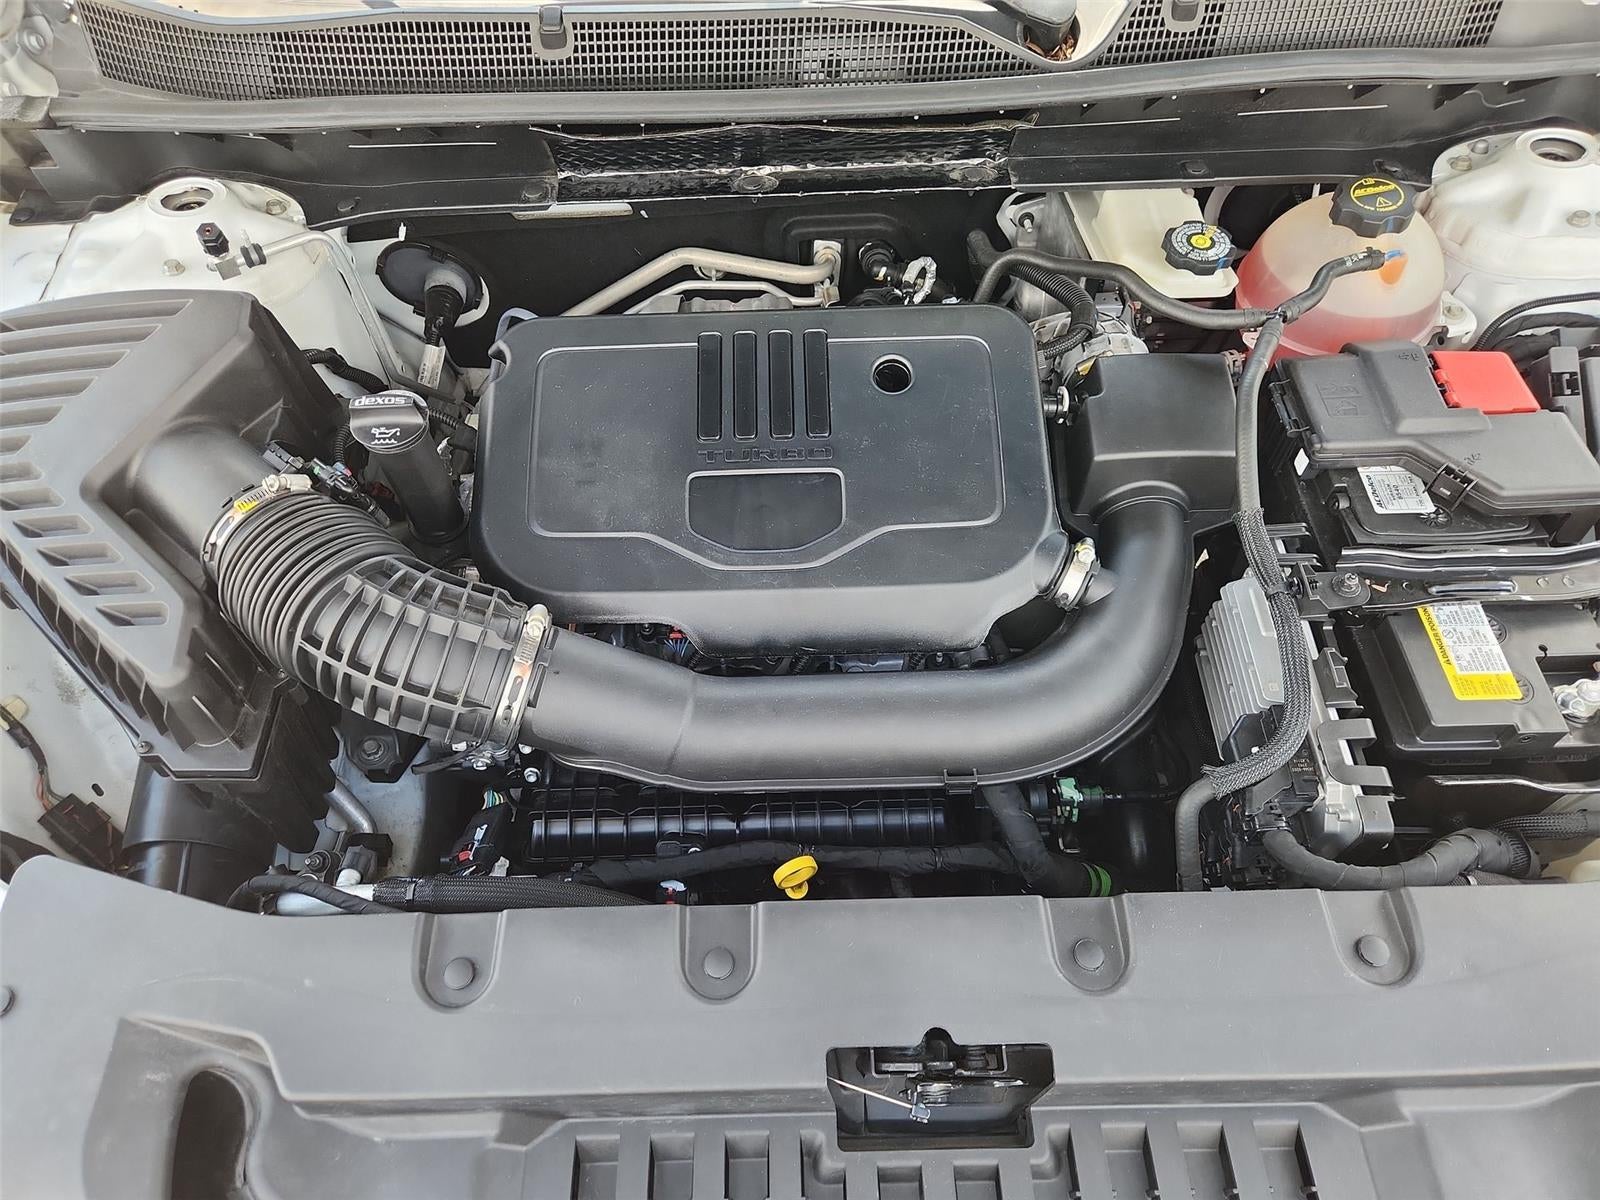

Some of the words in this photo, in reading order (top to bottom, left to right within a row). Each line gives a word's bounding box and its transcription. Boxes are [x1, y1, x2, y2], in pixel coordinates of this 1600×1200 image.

[354, 395, 406, 407] dexos
[697, 446, 833, 463] TURBO
[1365, 474, 1385, 509] ACDelco
[1421, 606, 1437, 631] POISON
